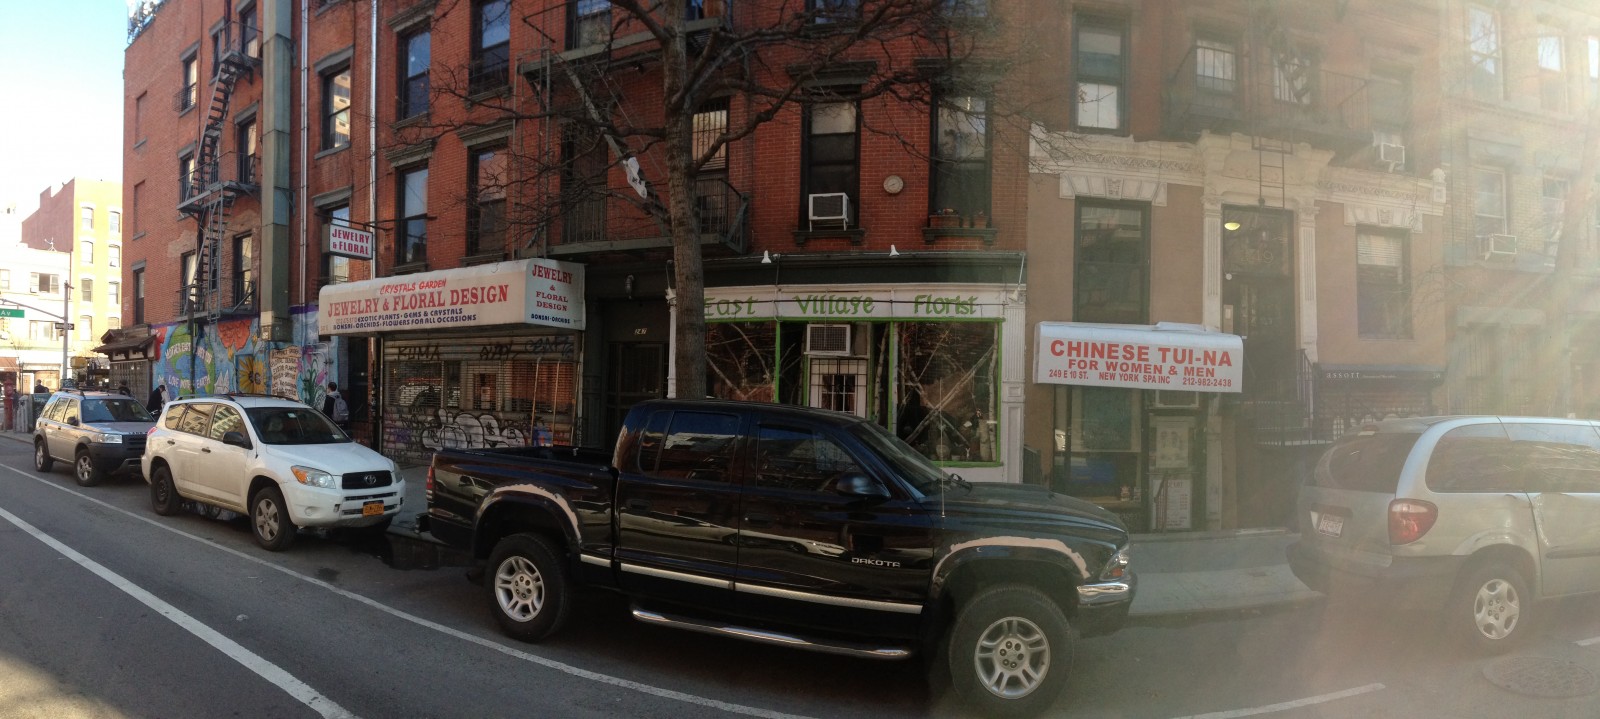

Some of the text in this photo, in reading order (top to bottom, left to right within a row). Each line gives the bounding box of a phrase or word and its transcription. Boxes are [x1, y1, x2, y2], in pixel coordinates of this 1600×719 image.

[332, 229, 369, 244] JEWELRY
[339, 241, 369, 255] FLORAL
[532, 264, 573, 284] JEWELRY
[380, 278, 446, 294] CRYSTALS GARDEN
[328, 285, 509, 317] JEWELRY & FLORAL DESIGN
[536, 291, 568, 302] FLORAL
[794, 295, 875, 315] Village
[913, 294, 978, 315] Florist
[537, 301, 567, 311] DESIGN
[437, 314, 476, 322] OCCASIONS
[1051, 340, 1232, 366] CHINESE TUI-NA
[1069, 360, 1215, 377] FOR WOMEN & MEN
[1049, 369, 1062, 378] 249
[1063, 370, 1068, 378] E
[1079, 371, 1088, 380] ST.
[1099, 372, 1116, 380] NEW
[1119, 373, 1139, 382] YORK
[1143, 374, 1156, 383] SPA
[1158, 375, 1170, 384] INC
[1183, 377, 1231, 387] 212-982-2438
[852, 557, 900, 568] DAKOTA
